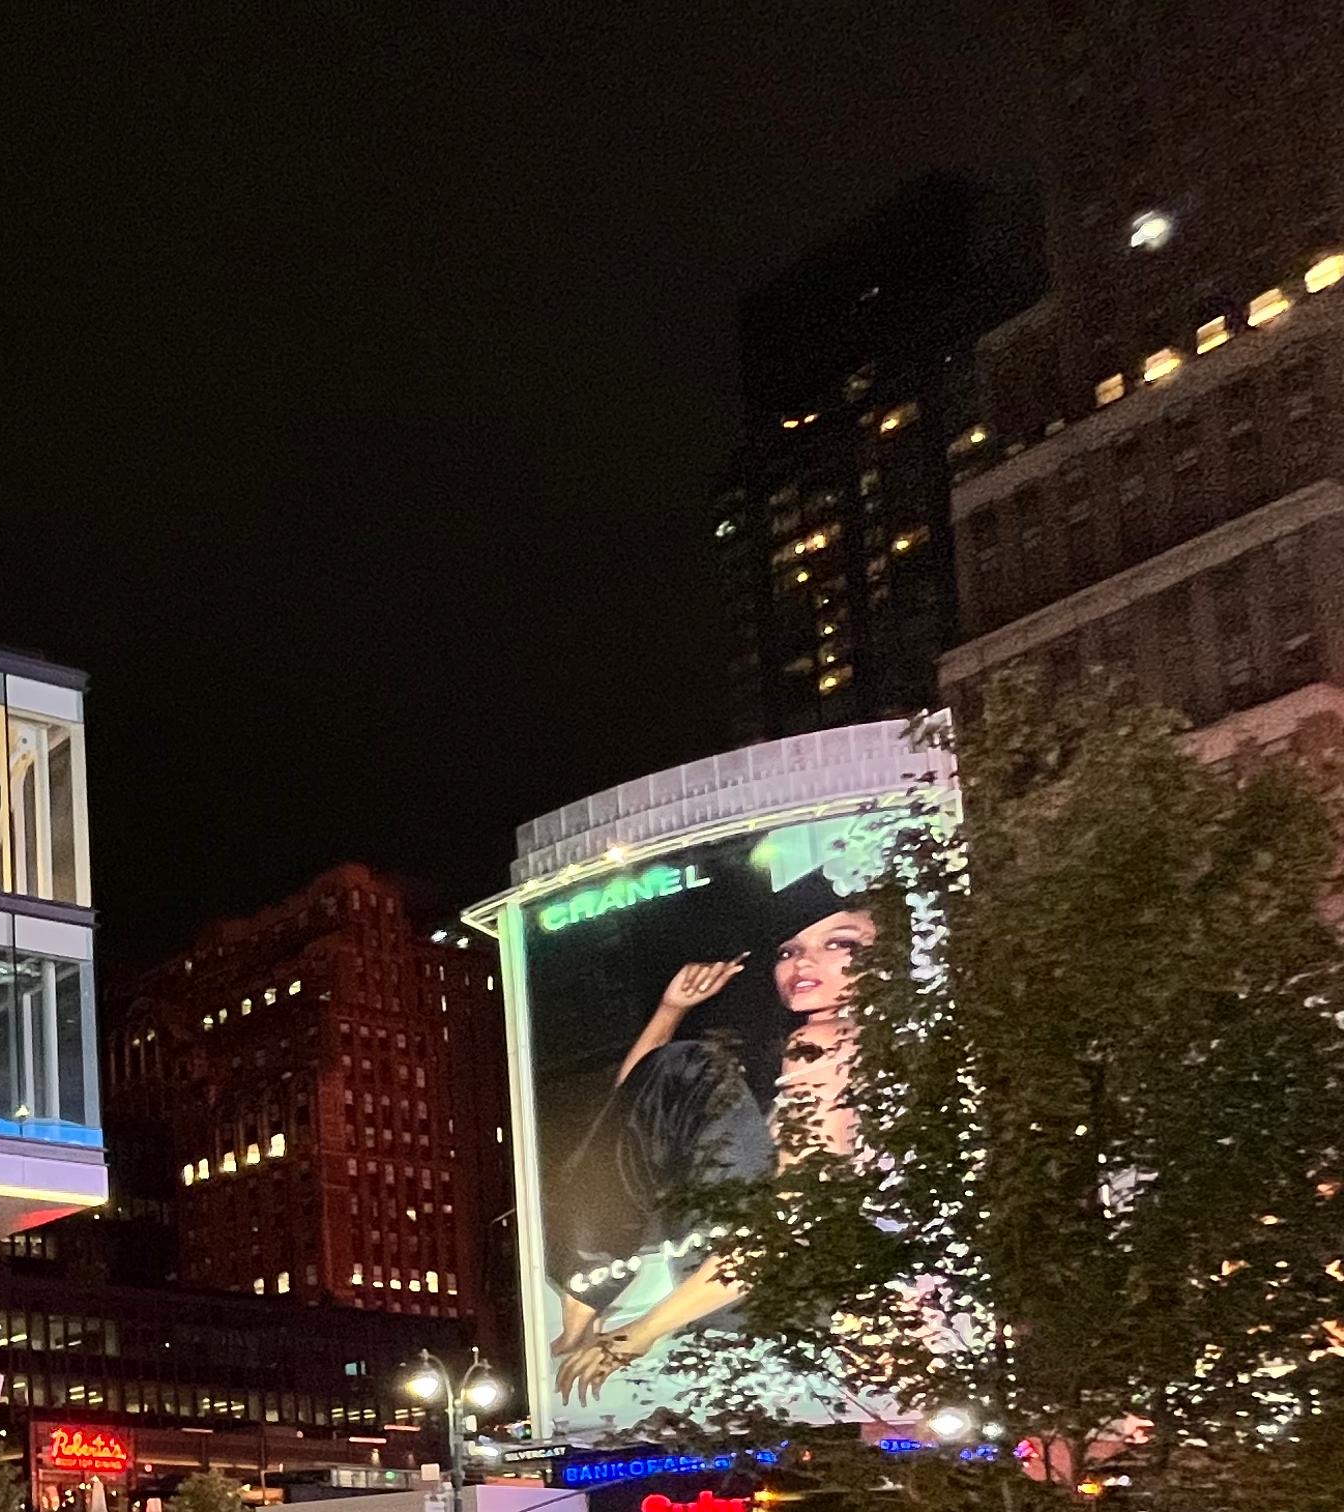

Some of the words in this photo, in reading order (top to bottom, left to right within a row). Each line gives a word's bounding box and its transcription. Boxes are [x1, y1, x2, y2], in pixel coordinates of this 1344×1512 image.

[541, 864, 711, 932] CHANEL
[51, 1427, 127, 1460] Roberta's
[566, 1461, 625, 1482] BANK
[629, 1459, 658, 1476] OF
